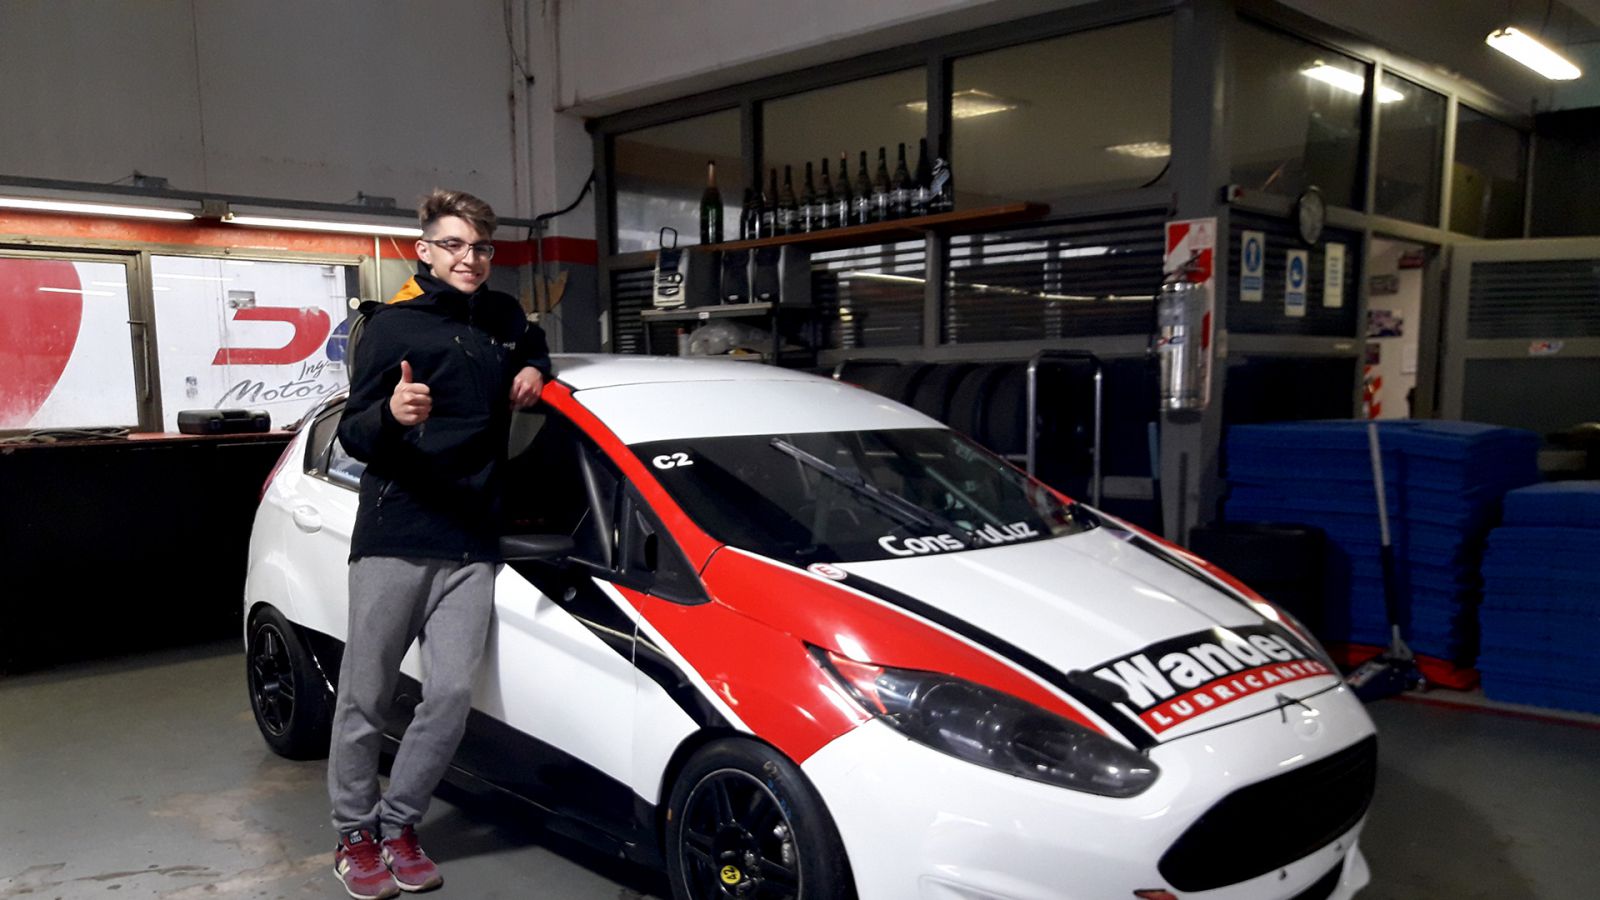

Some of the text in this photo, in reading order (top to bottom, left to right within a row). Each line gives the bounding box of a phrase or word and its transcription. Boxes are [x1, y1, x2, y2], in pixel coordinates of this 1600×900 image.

[214, 379, 349, 409] Motors
[653, 452, 694, 469] C2
[878, 521, 1039, 556] ConsuLuz
[1093, 633, 1306, 709] Wander
[1150, 660, 1328, 727] LUBRICANTES
